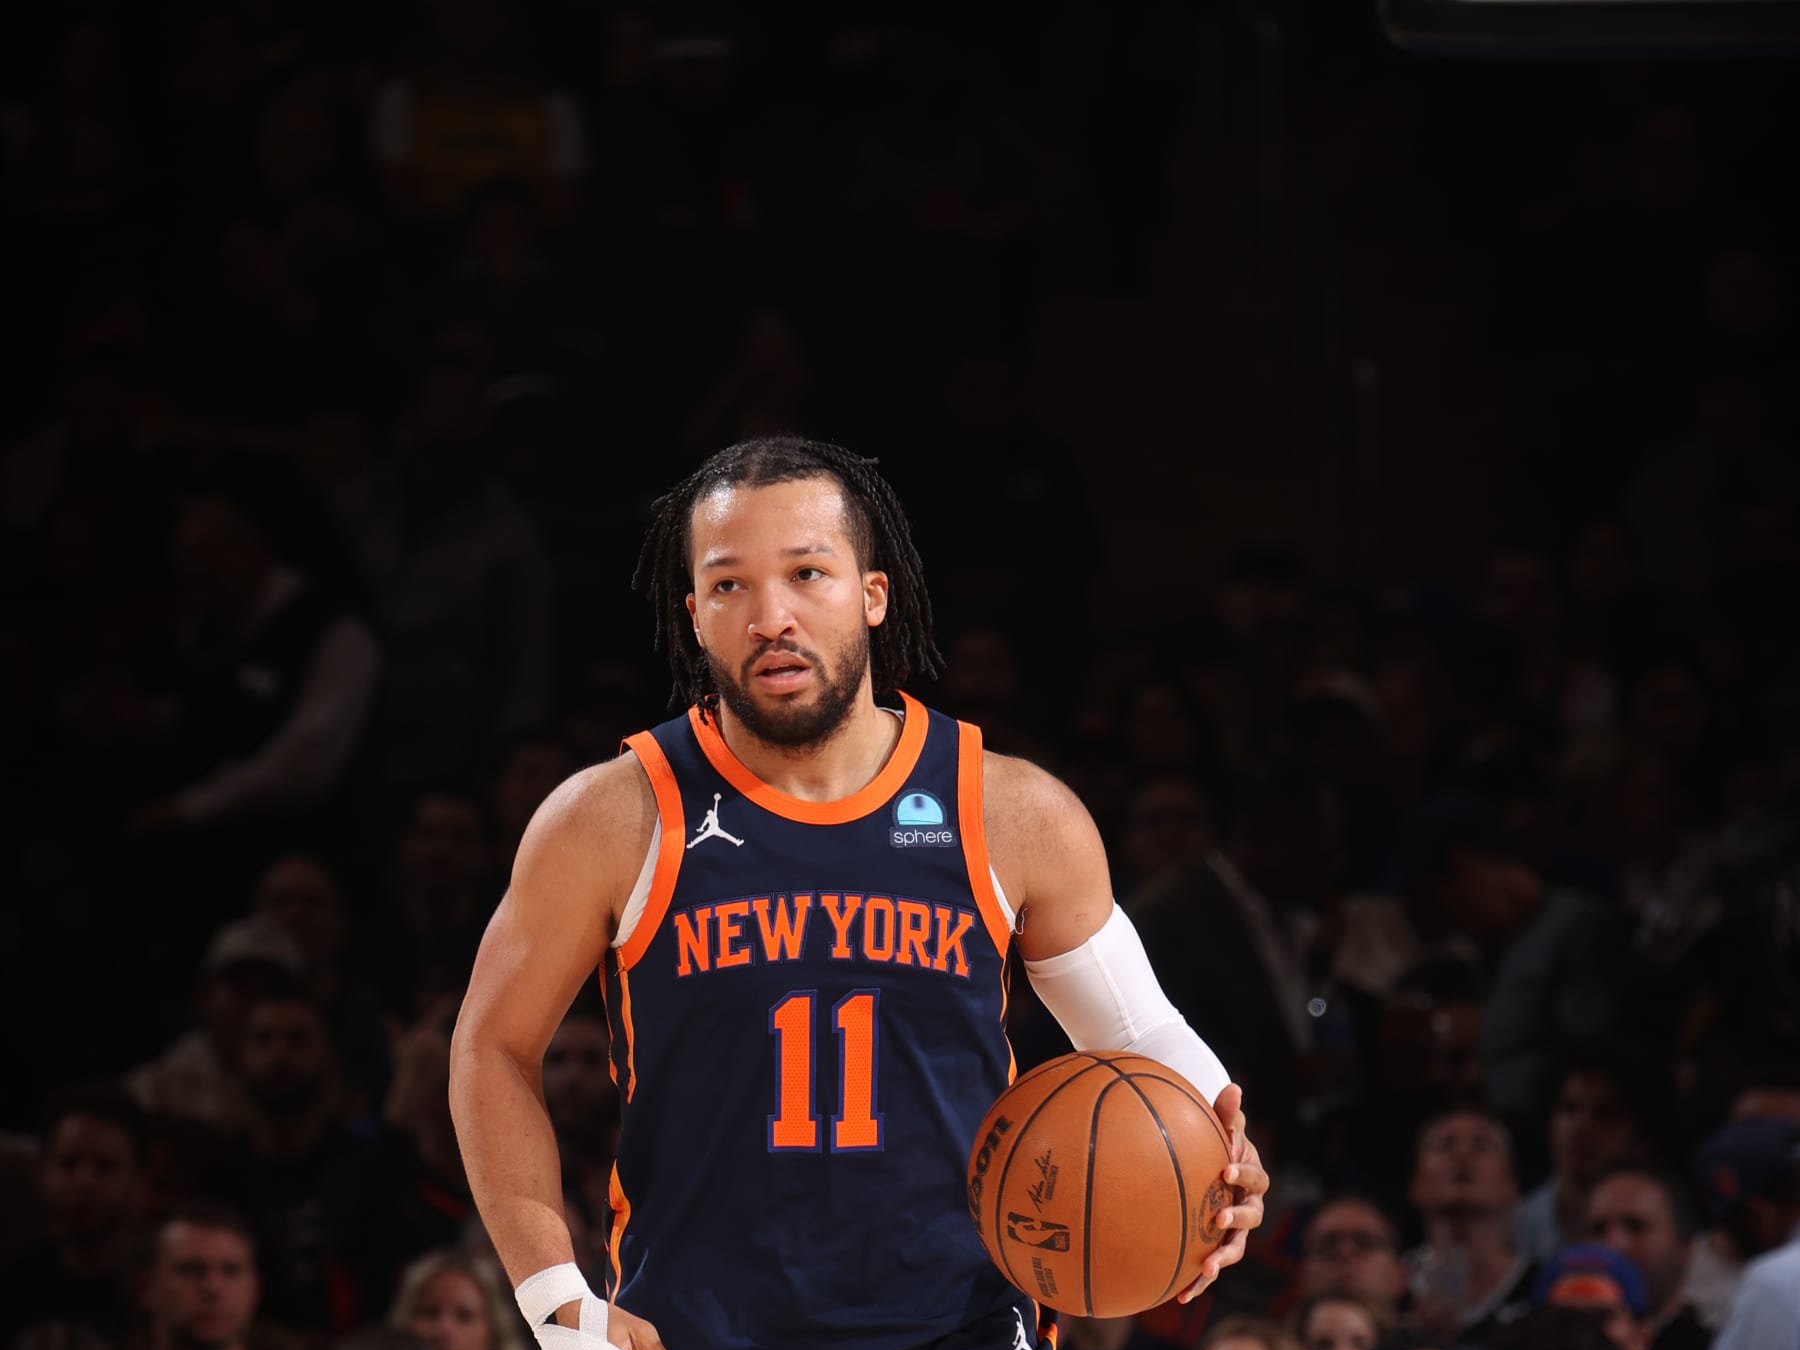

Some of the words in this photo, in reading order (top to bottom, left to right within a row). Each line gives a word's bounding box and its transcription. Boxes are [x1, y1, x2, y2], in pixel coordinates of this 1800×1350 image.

[894, 829, 953, 847] sphere
[674, 890, 815, 978] NEW
[818, 890, 977, 979] YORK
[768, 988, 885, 1153] 11
